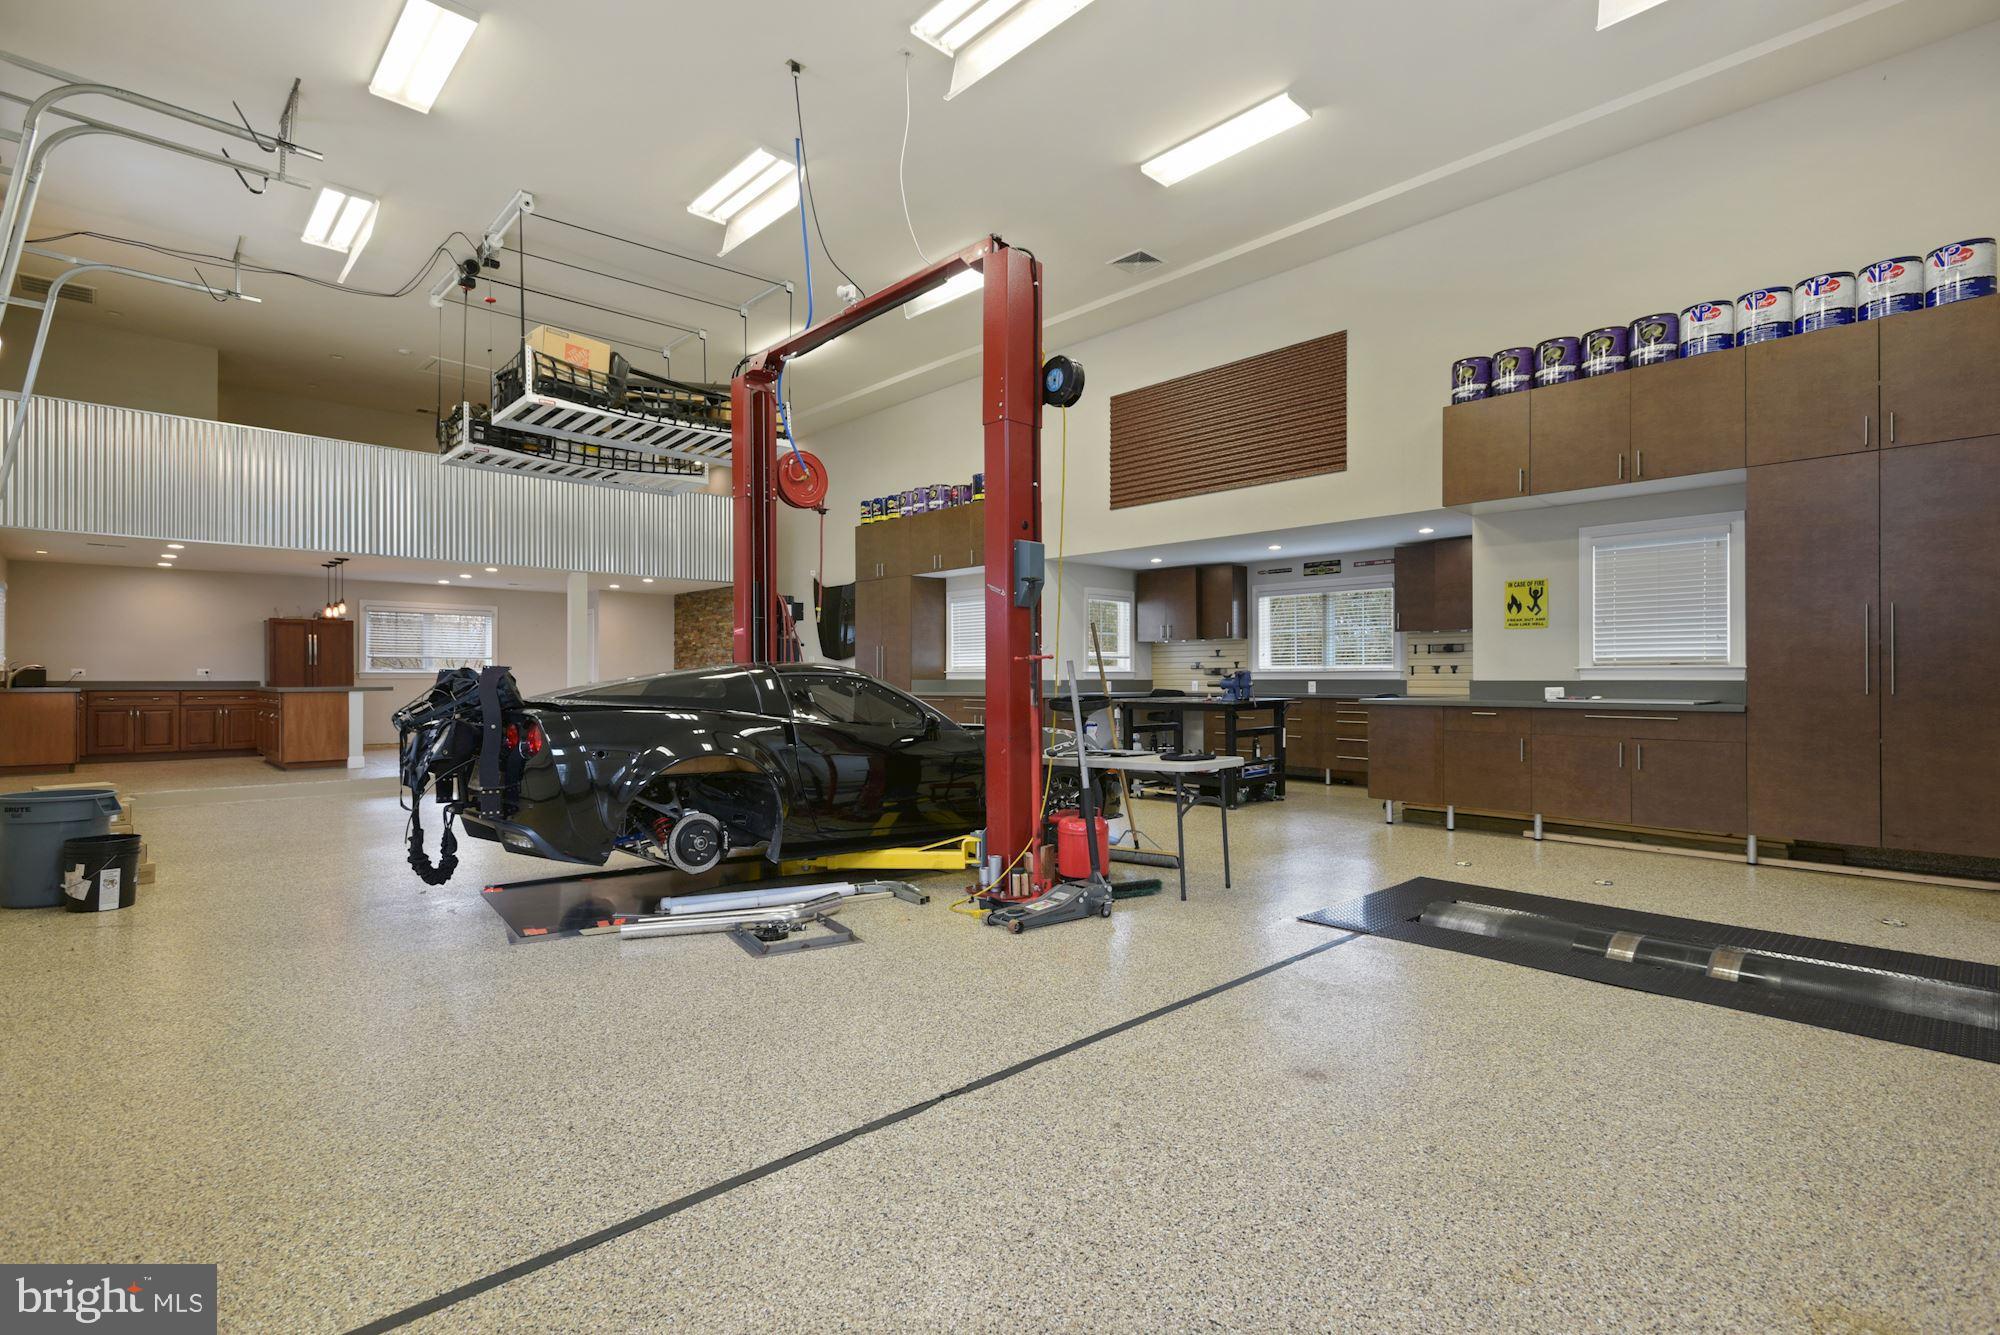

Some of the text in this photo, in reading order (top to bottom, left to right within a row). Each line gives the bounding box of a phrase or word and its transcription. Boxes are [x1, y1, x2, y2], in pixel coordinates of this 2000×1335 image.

[1934, 244, 1961, 269] VP
[1867, 261, 1894, 283] VP
[1805, 275, 1831, 297] VP
[1745, 289, 1768, 311] VP
[1690, 303, 1712, 322] VP
